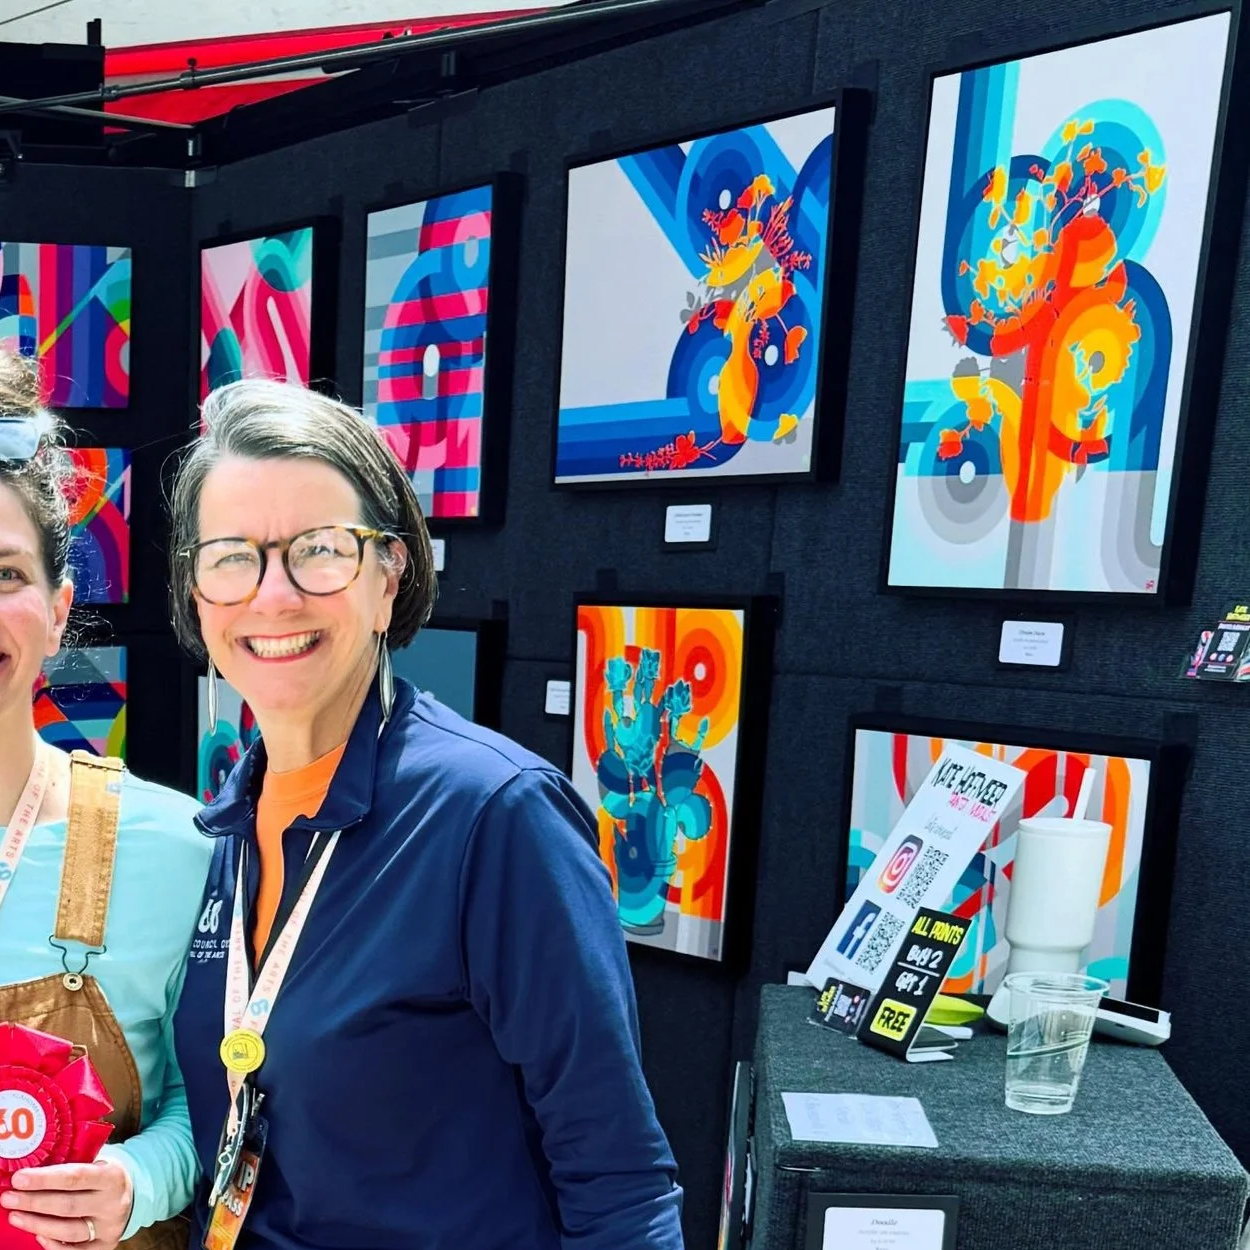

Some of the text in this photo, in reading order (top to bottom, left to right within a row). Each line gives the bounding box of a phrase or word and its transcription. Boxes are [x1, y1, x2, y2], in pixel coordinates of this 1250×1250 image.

[19, 803, 34, 825] THE
[5, 829, 25, 859] ARTS
[911, 915, 965, 945] ALL PRINTS
[928, 950, 944, 969] 2
[913, 976, 929, 996] 1
[877, 1006, 911, 1033] FREE
[237, 1160, 255, 1192] IP
